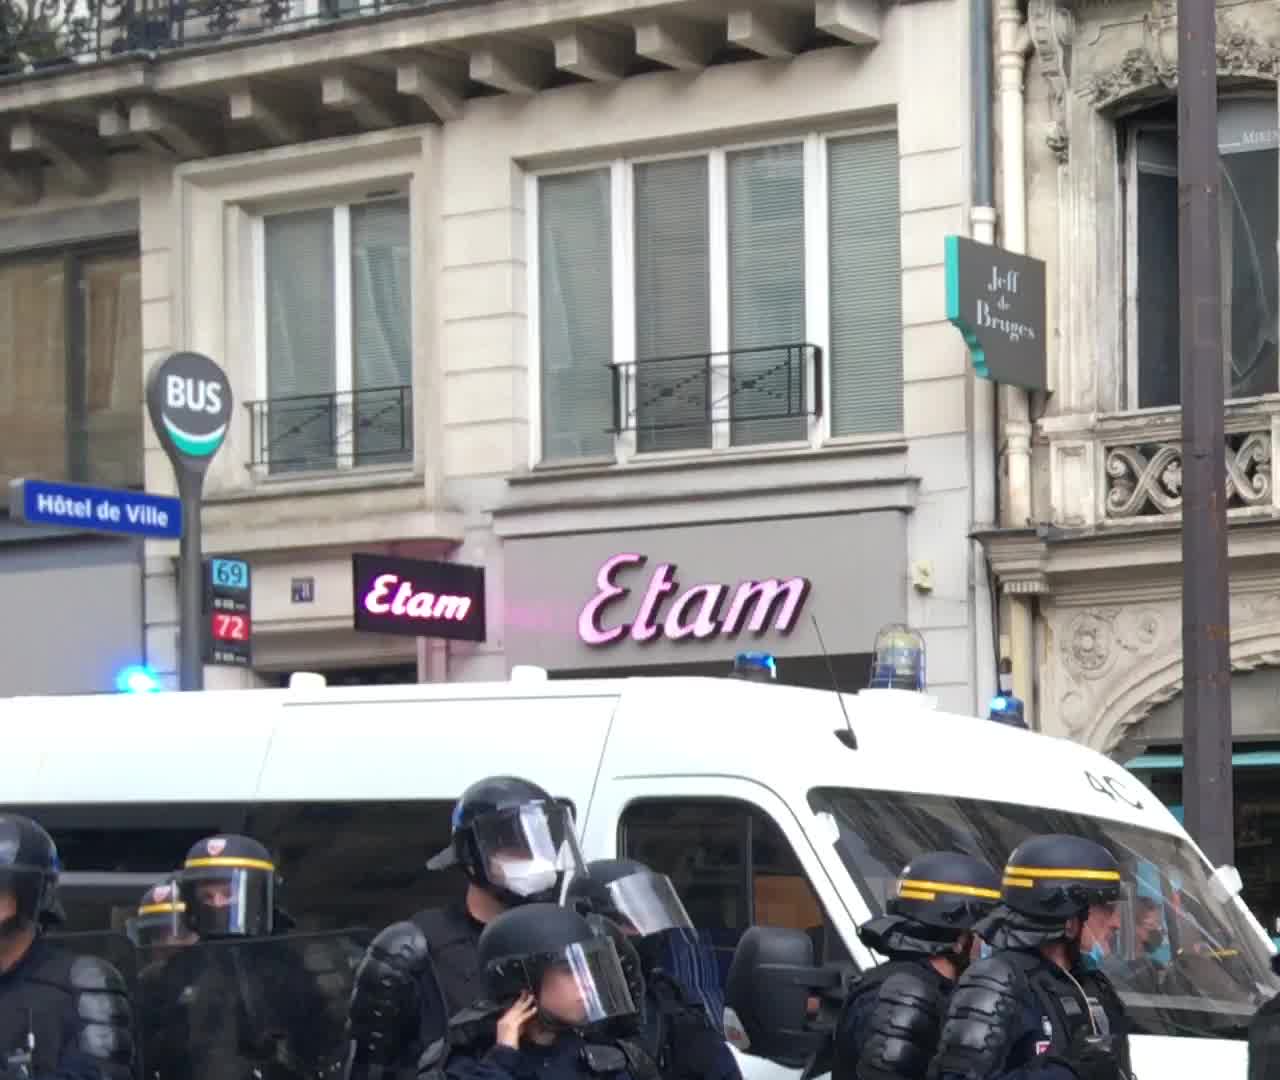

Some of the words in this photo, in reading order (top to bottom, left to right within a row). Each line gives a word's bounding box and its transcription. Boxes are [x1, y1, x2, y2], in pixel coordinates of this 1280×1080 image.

[988, 266, 1020, 293] Jeff
[977, 300, 1035, 341] Bruges
[997, 296, 1010, 311] de
[166, 374, 222, 414] BUS
[37, 493, 91, 518] Hôtel
[96, 501, 120, 521] de
[126, 503, 169, 527] Ville
[217, 562, 243, 584] 69
[364, 573, 471, 621] Etam
[577, 552, 807, 645] Etam
[217, 614, 244, 639] 72
[1084, 770, 1144, 810] 4C
